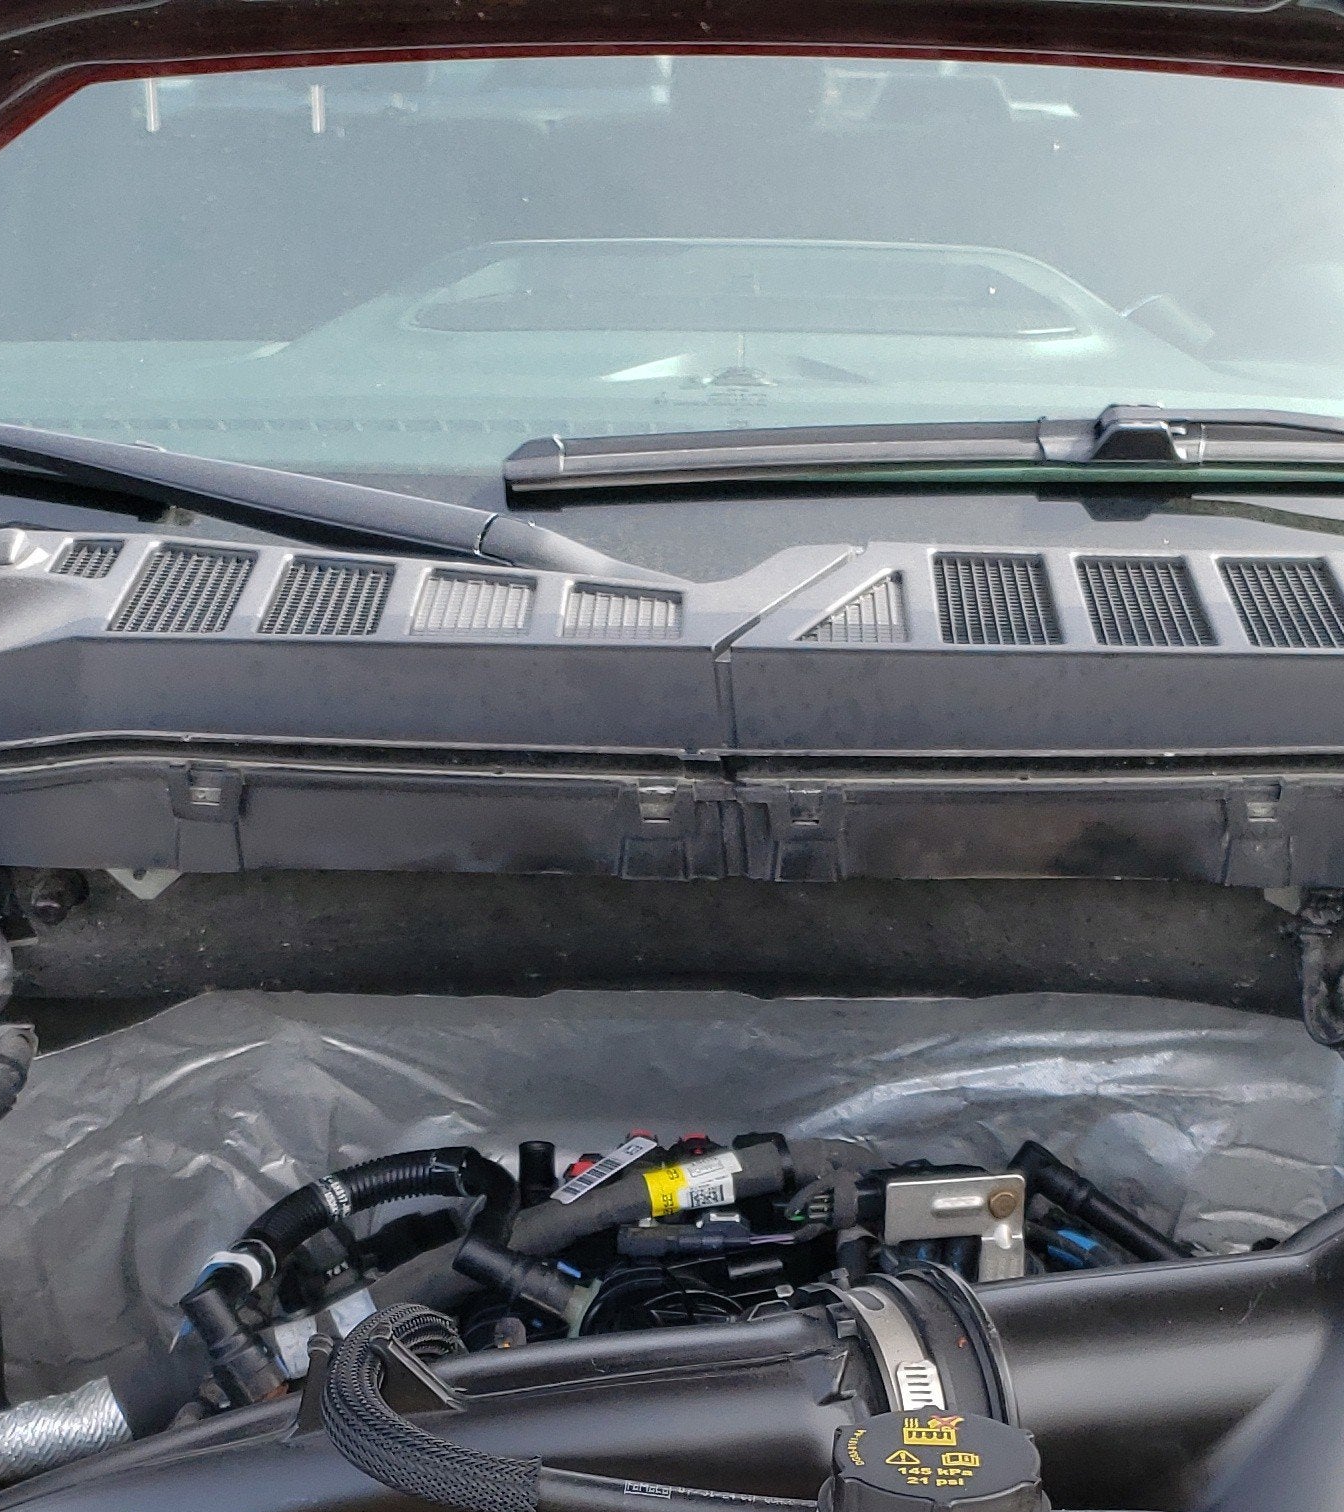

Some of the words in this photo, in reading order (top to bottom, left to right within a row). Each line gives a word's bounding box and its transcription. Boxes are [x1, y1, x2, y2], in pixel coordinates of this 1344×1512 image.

[897, 1467, 933, 1476] 145
[937, 1467, 973, 1477] kPa
[906, 1476, 929, 1485] 21
[936, 1477, 965, 1487] psi
